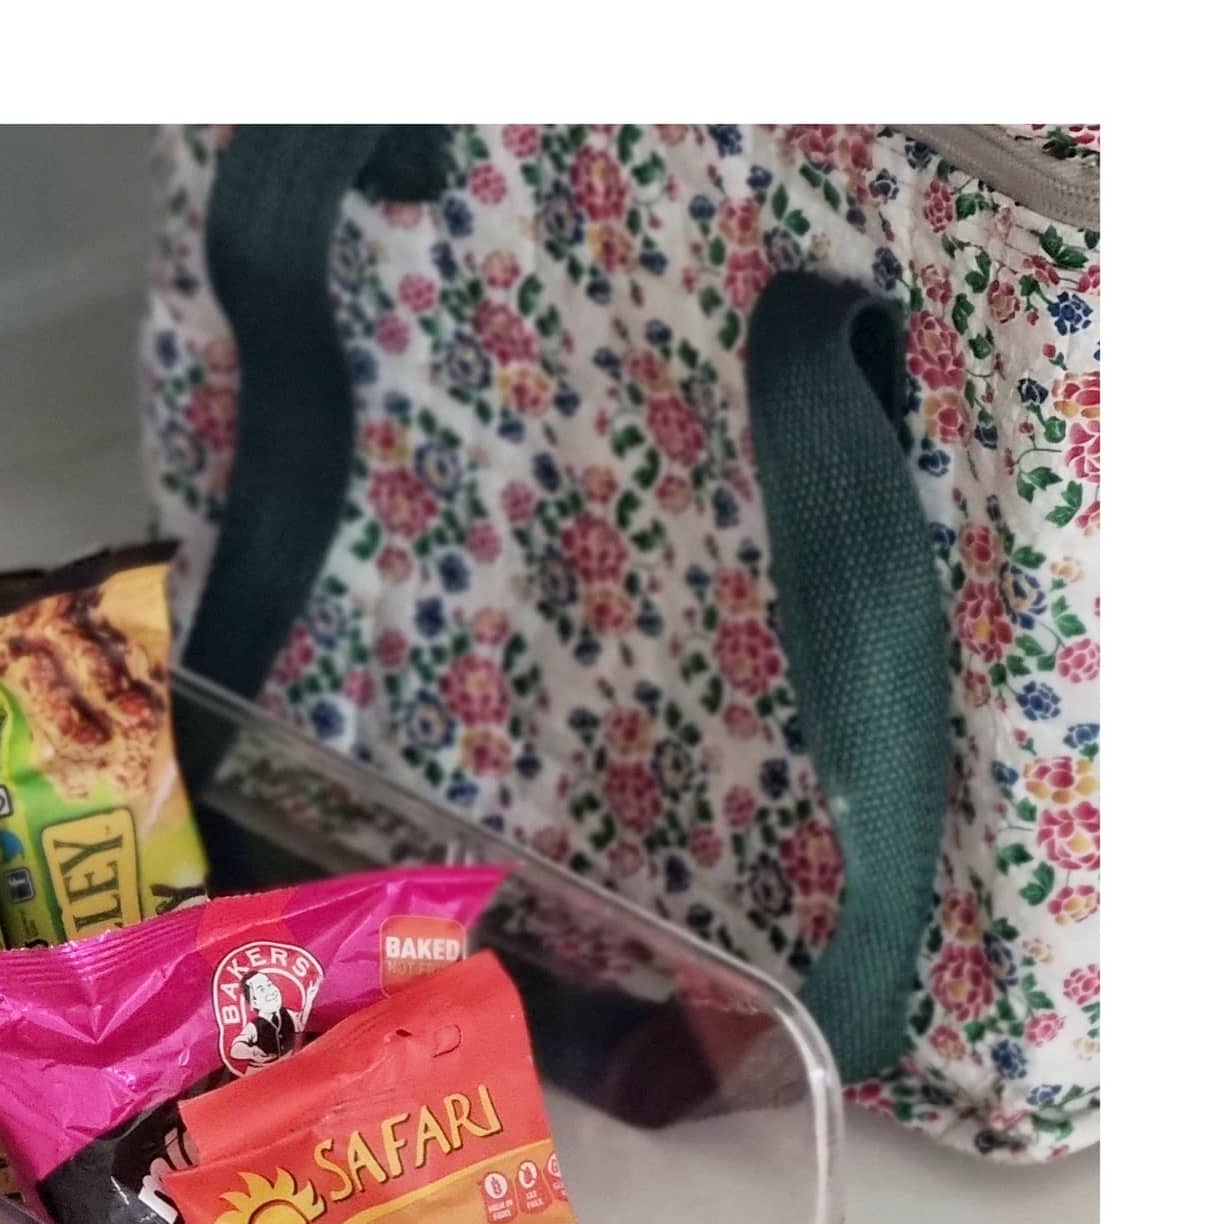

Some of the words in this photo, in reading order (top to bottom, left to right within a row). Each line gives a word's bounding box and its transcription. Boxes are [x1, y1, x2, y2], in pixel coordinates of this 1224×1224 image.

[220, 947, 312, 1026] BAKERS
[385, 935, 460, 961] BAKED
[314, 1084, 503, 1203] SAFARI
